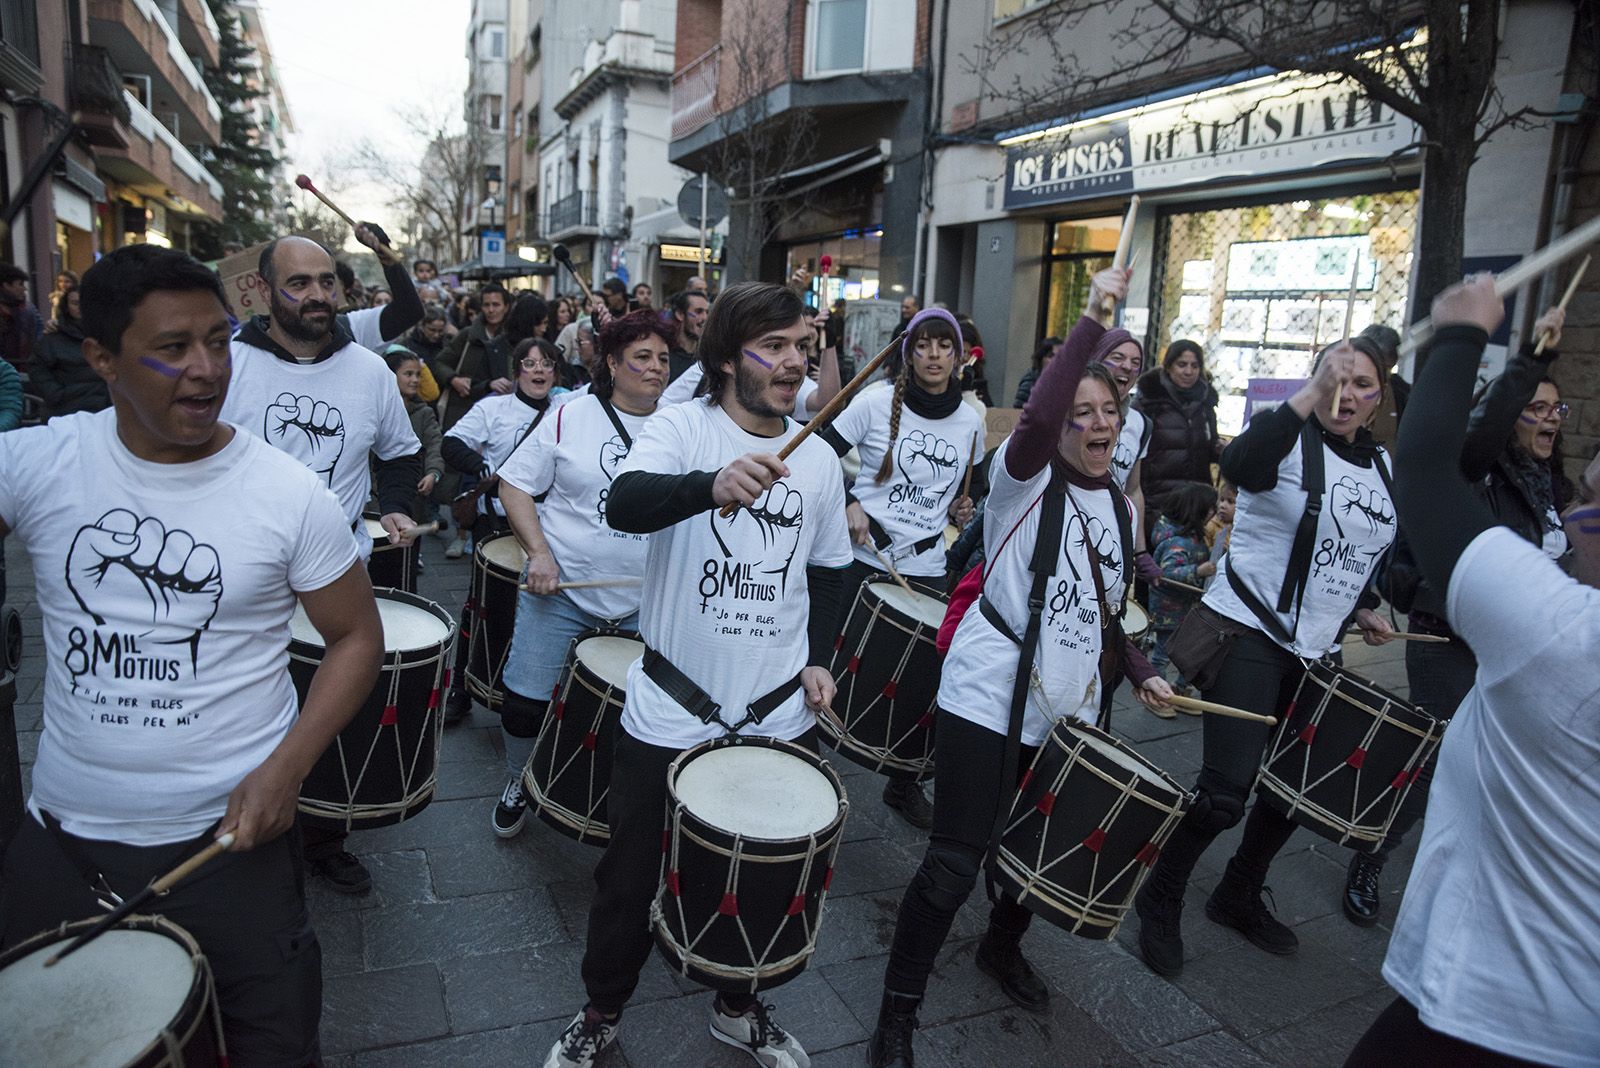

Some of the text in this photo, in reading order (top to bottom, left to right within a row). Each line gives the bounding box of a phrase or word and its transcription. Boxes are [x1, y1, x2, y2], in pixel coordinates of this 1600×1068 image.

[1012, 137, 1125, 187] 101 PISOS
[735, 612, 749, 622] PER
[756, 614, 775, 625] ELLES
[721, 627, 742, 636] ELLES
[749, 628, 764, 638] PER
[118, 695, 138, 708] PER
[151, 699, 184, 710] ELLES
[100, 713, 129, 725] ELLES
[143, 716, 166, 728] PER
